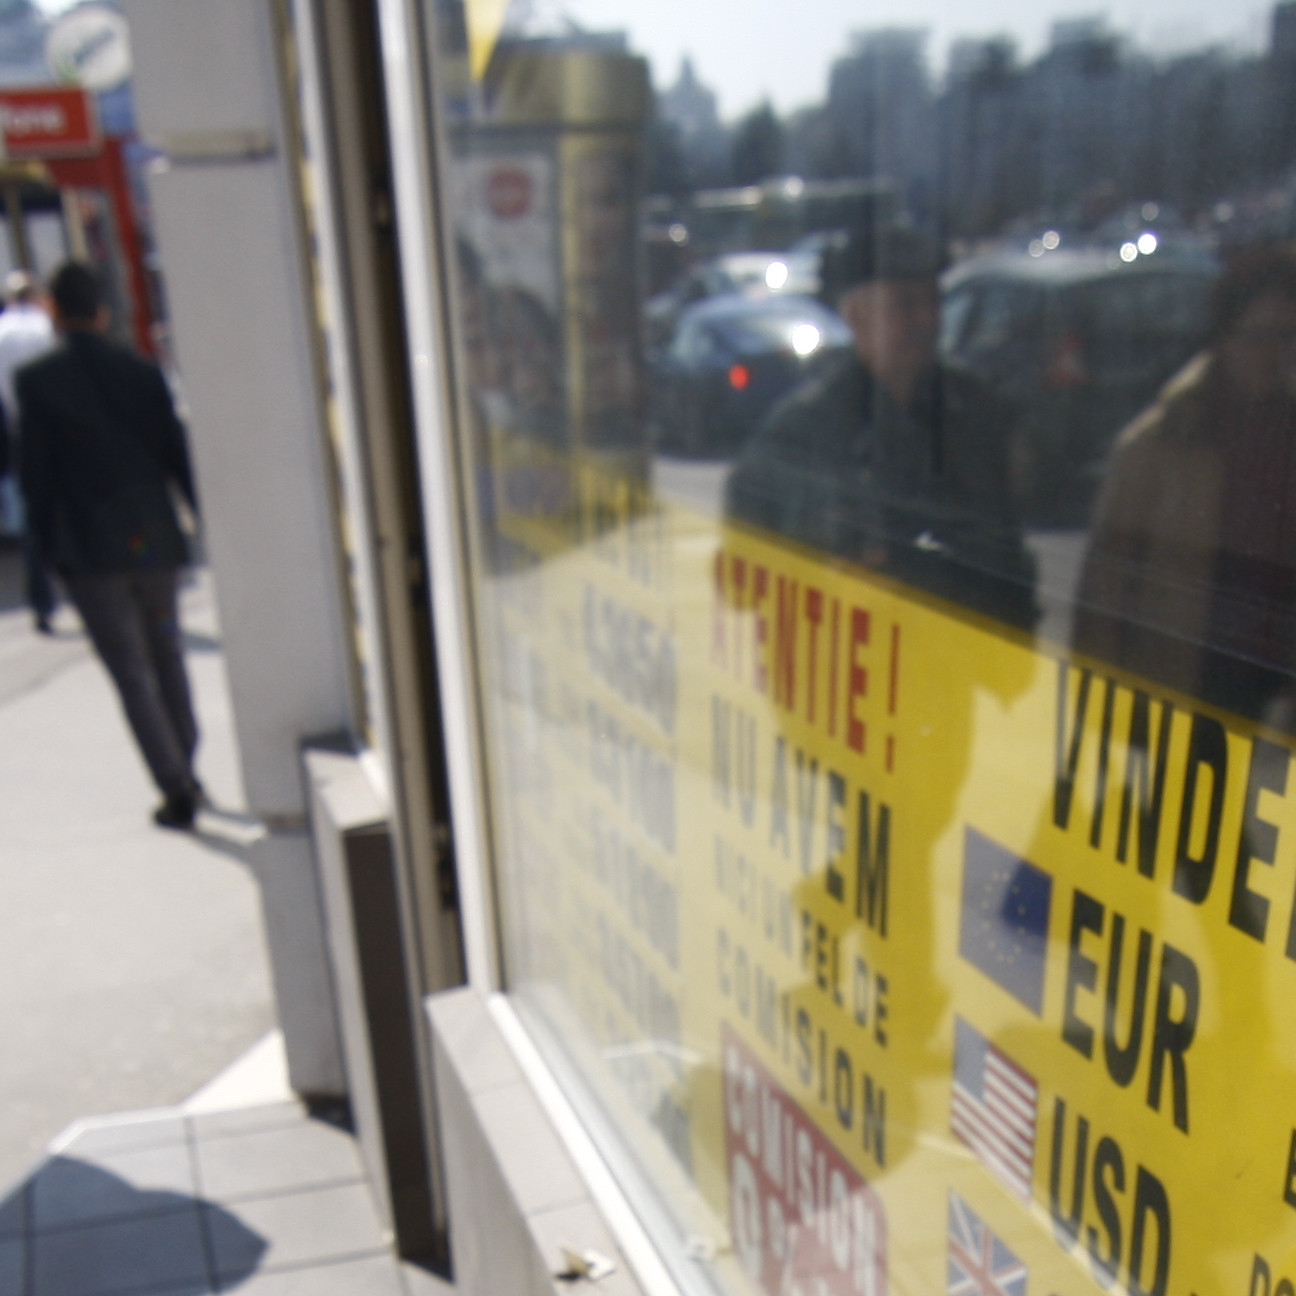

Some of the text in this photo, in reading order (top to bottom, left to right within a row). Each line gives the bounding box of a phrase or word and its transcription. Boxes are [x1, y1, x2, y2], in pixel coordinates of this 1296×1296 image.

[770, 734, 892, 938] AVEM
[716, 925, 887, 1170] COMISION
[1060, 888, 1200, 1136] EUR
